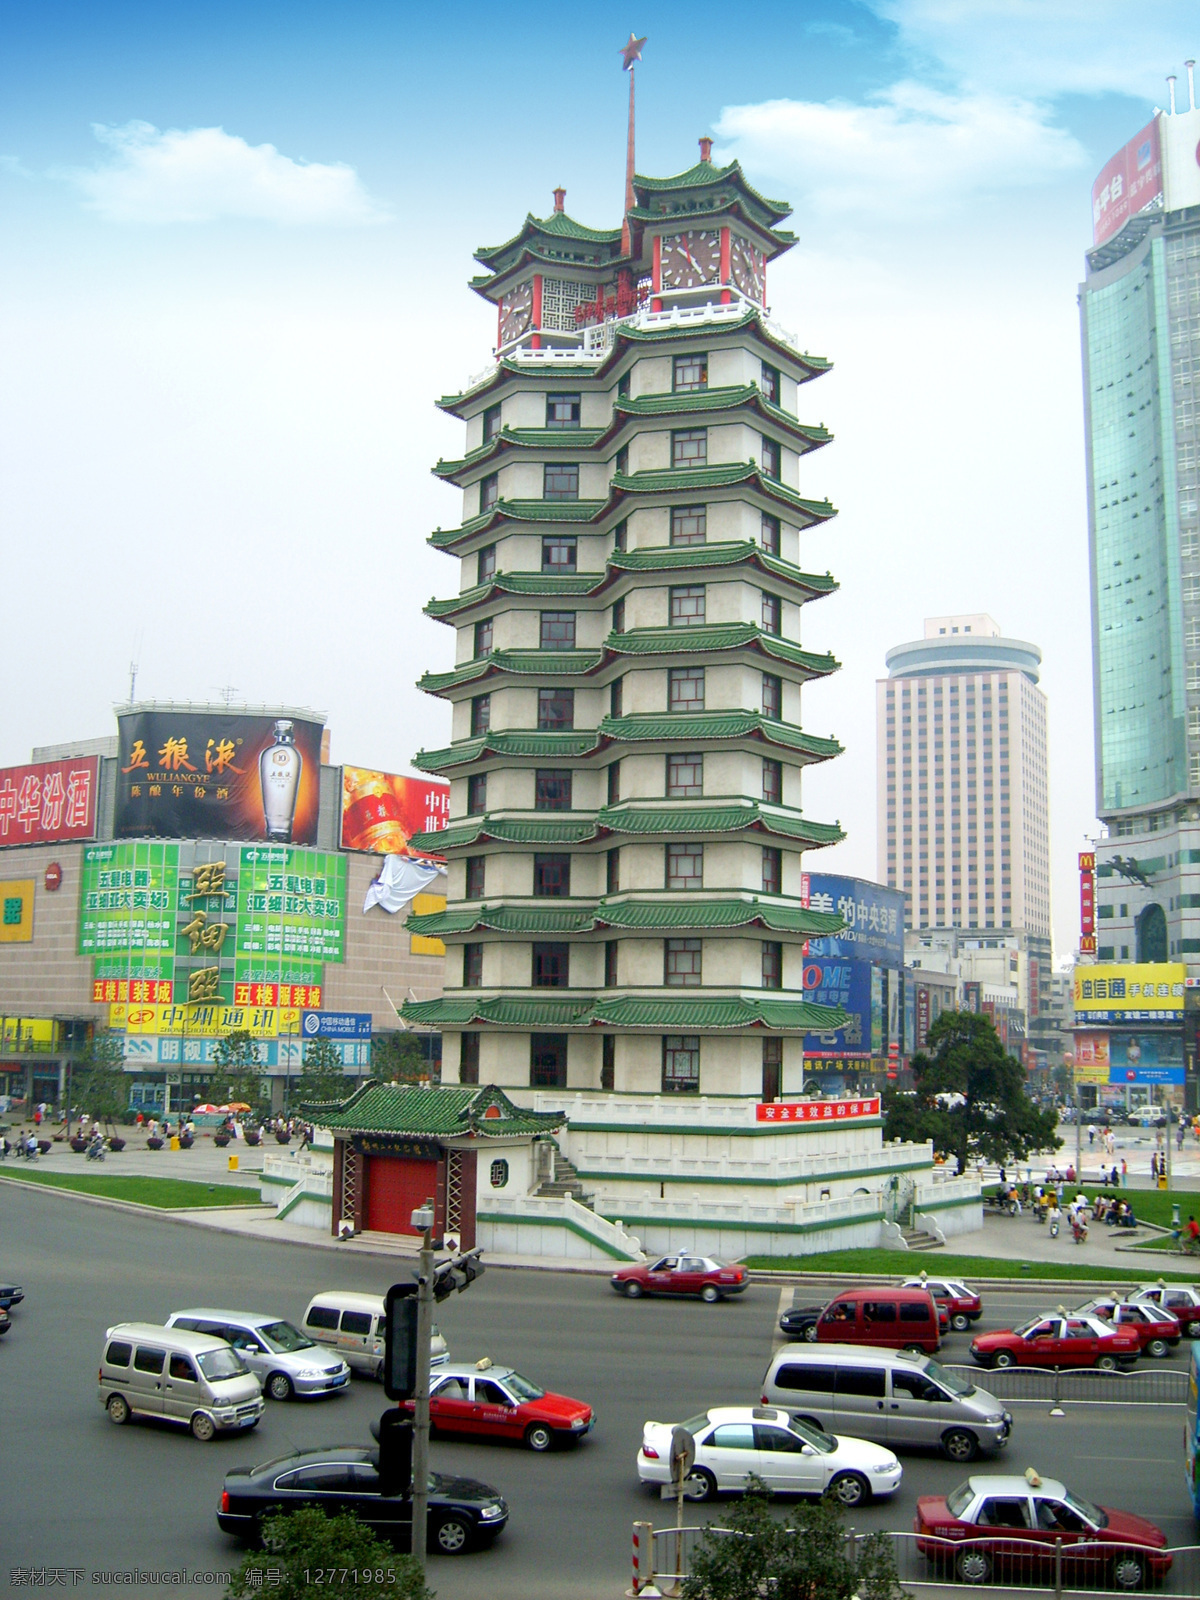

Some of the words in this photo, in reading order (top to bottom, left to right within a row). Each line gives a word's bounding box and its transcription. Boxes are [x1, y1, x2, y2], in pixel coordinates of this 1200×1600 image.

[121, 737, 247, 774] 五粮液
[146, 773, 210, 784] WULIANGYE
[0, 770, 91, 836] 中华汾酒
[131, 785, 229, 799] 陈酿年份酒
[99, 869, 151, 889] 五星电器
[268, 874, 327, 895] 五星电器
[86, 891, 169, 911] 亚细亚大卖场
[247, 894, 339, 917] 亚细亚大卖场
[810, 893, 896, 936] 美的中央空调
[94, 980, 170, 1003] 五楼服装城
[235, 984, 321, 1008] 五楼服装城
[1082, 977, 1126, 999] 迪信通
[1129, 982, 1184, 998] 手机连锁
[162, 1006, 274, 1028] 中州通讯
[161, 1038, 269, 1064] 明视达镜
[766, 1103, 871, 1118] 安全是效益的保障
